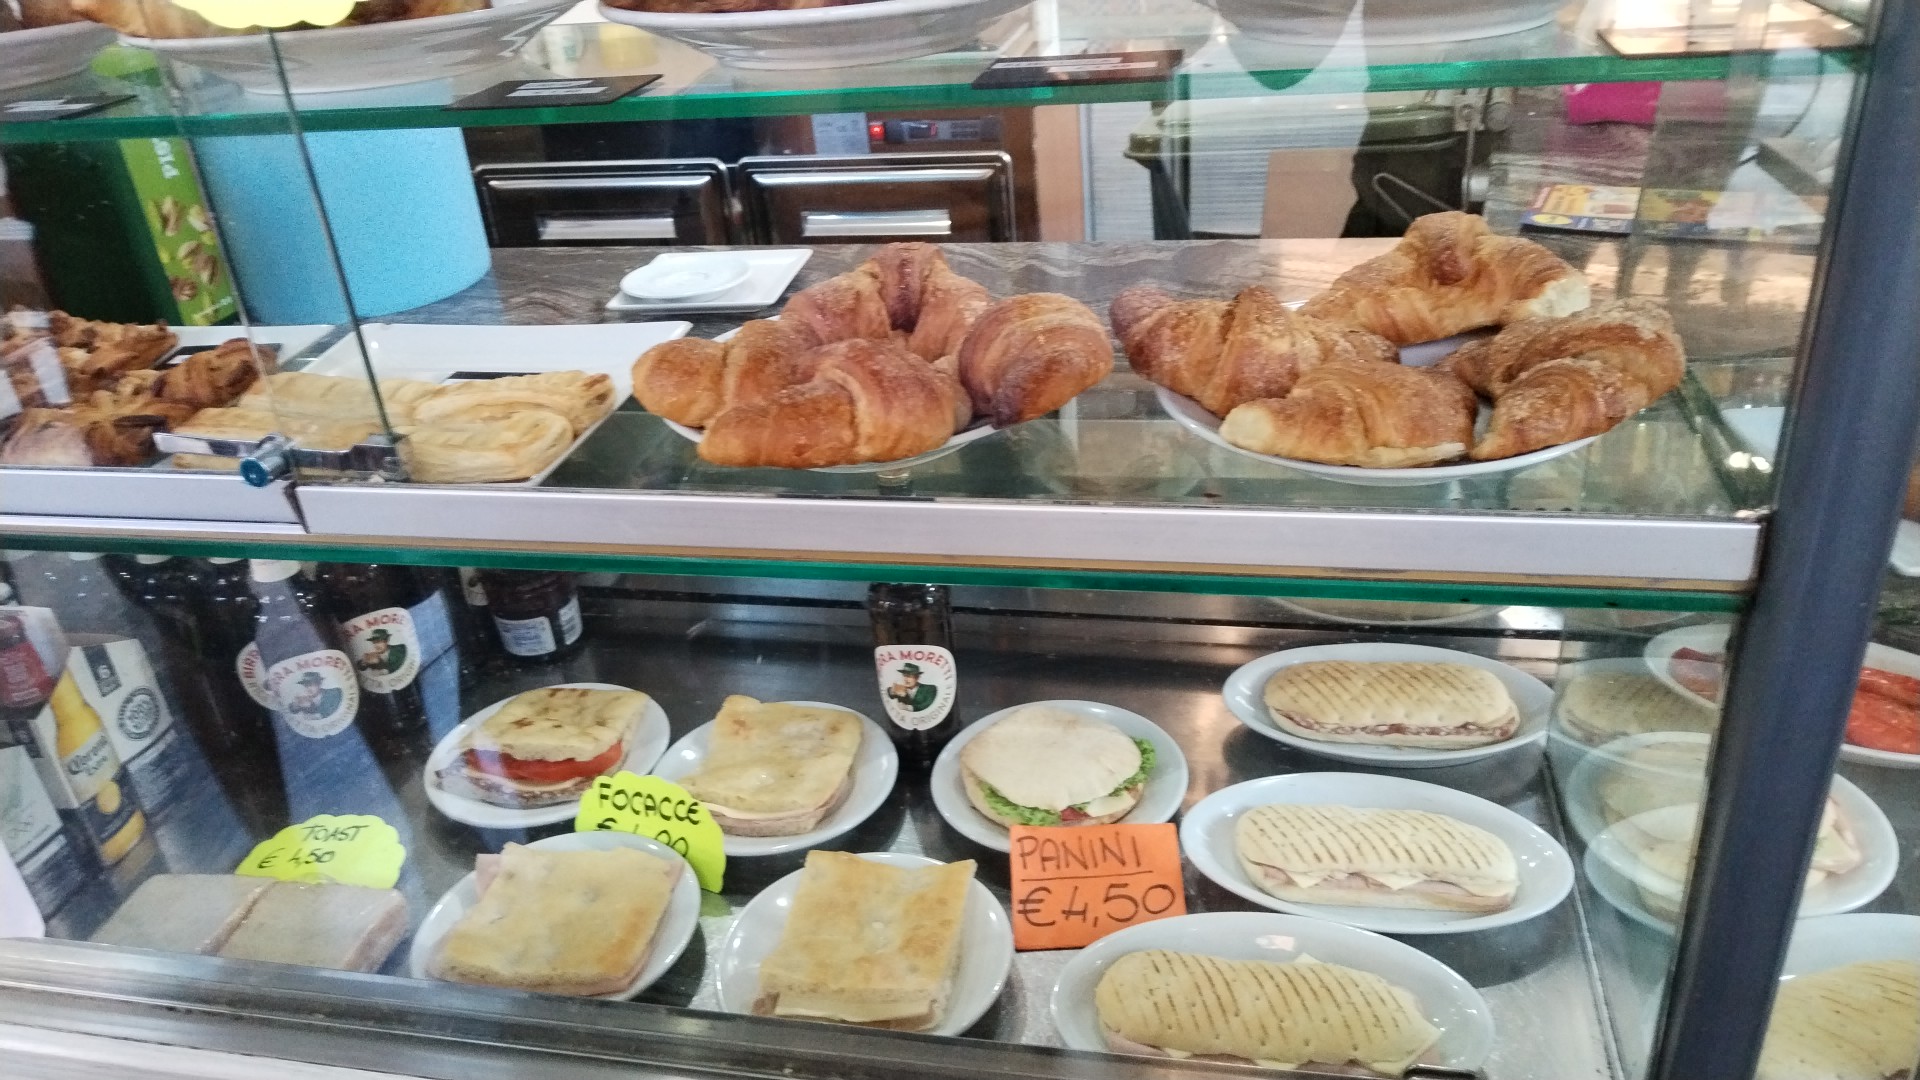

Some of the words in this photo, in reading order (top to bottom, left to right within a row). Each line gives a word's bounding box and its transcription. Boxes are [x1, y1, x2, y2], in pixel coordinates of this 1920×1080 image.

[599, 782, 701, 826] FOCACCE
[301, 824, 371, 842] TOAST
[1016, 831, 1142, 873] PANINI
[1017, 886, 1057, 928] €
[1061, 882, 1177, 928] 4,50
